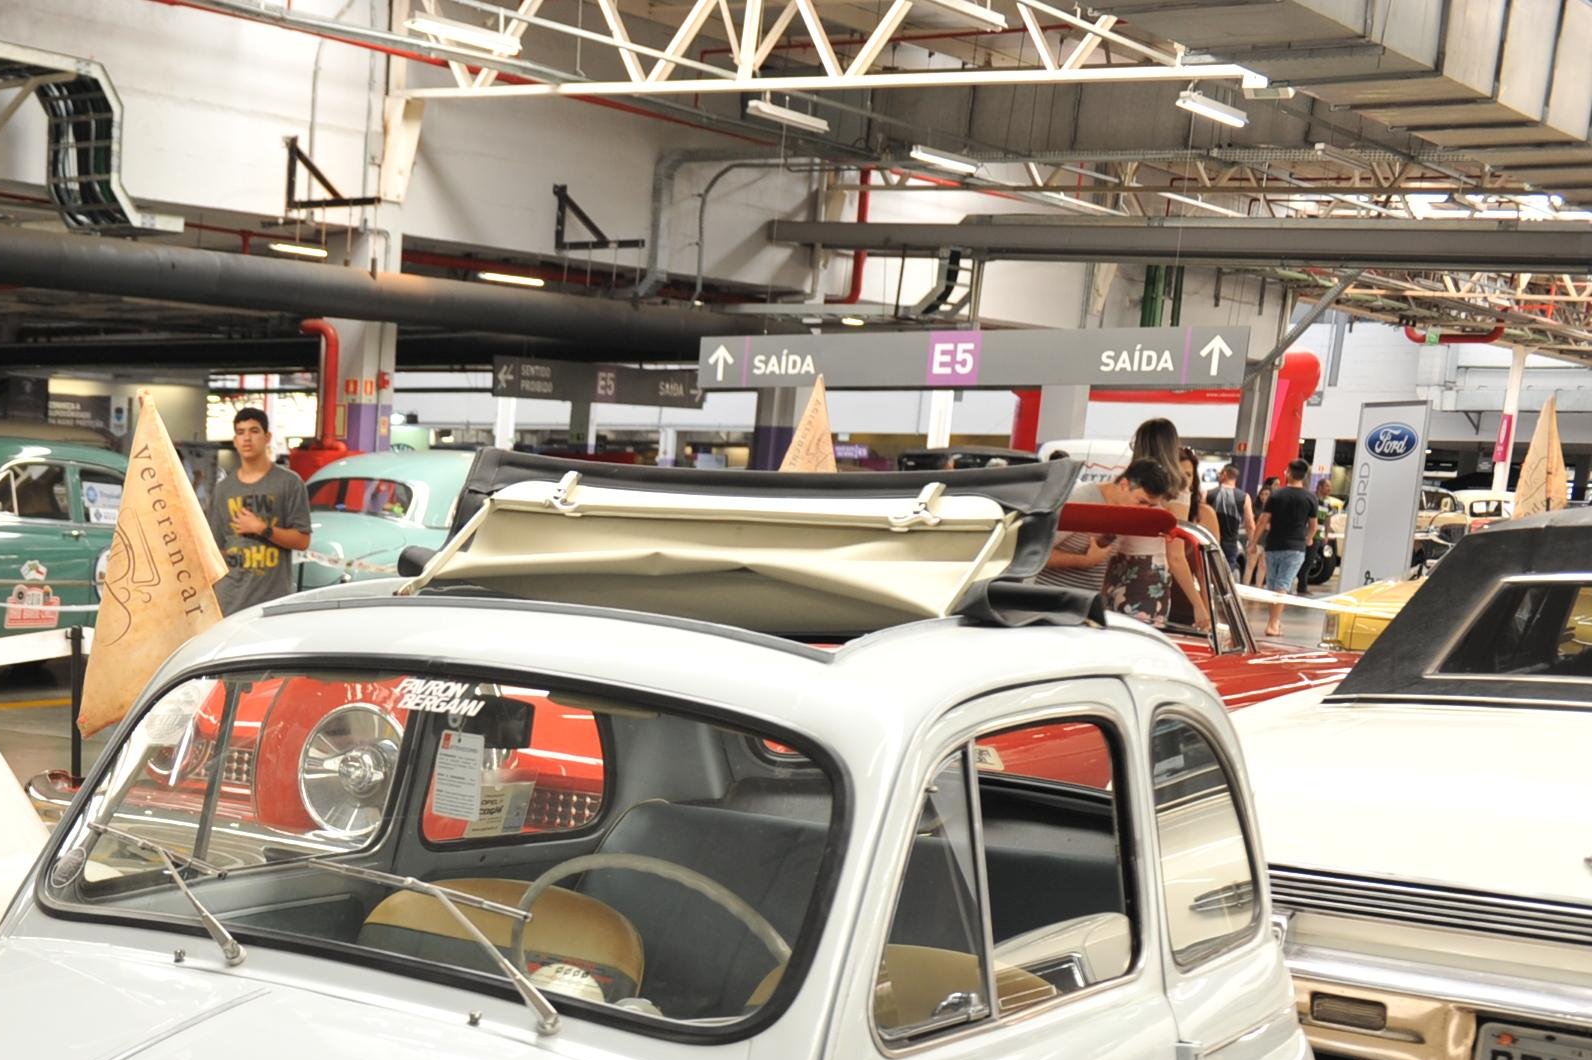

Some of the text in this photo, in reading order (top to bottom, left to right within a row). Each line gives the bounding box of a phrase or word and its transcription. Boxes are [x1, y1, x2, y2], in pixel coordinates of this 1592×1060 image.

[752, 349, 815, 375] SAÍDA
[932, 342, 975, 374] E5
[1100, 344, 1174, 372] SAÍDA
[596, 372, 616, 396] E5
[1374, 429, 1409, 455] Ford
[1352, 462, 1370, 530] FORD
[133, 443, 203, 617] veterancar
